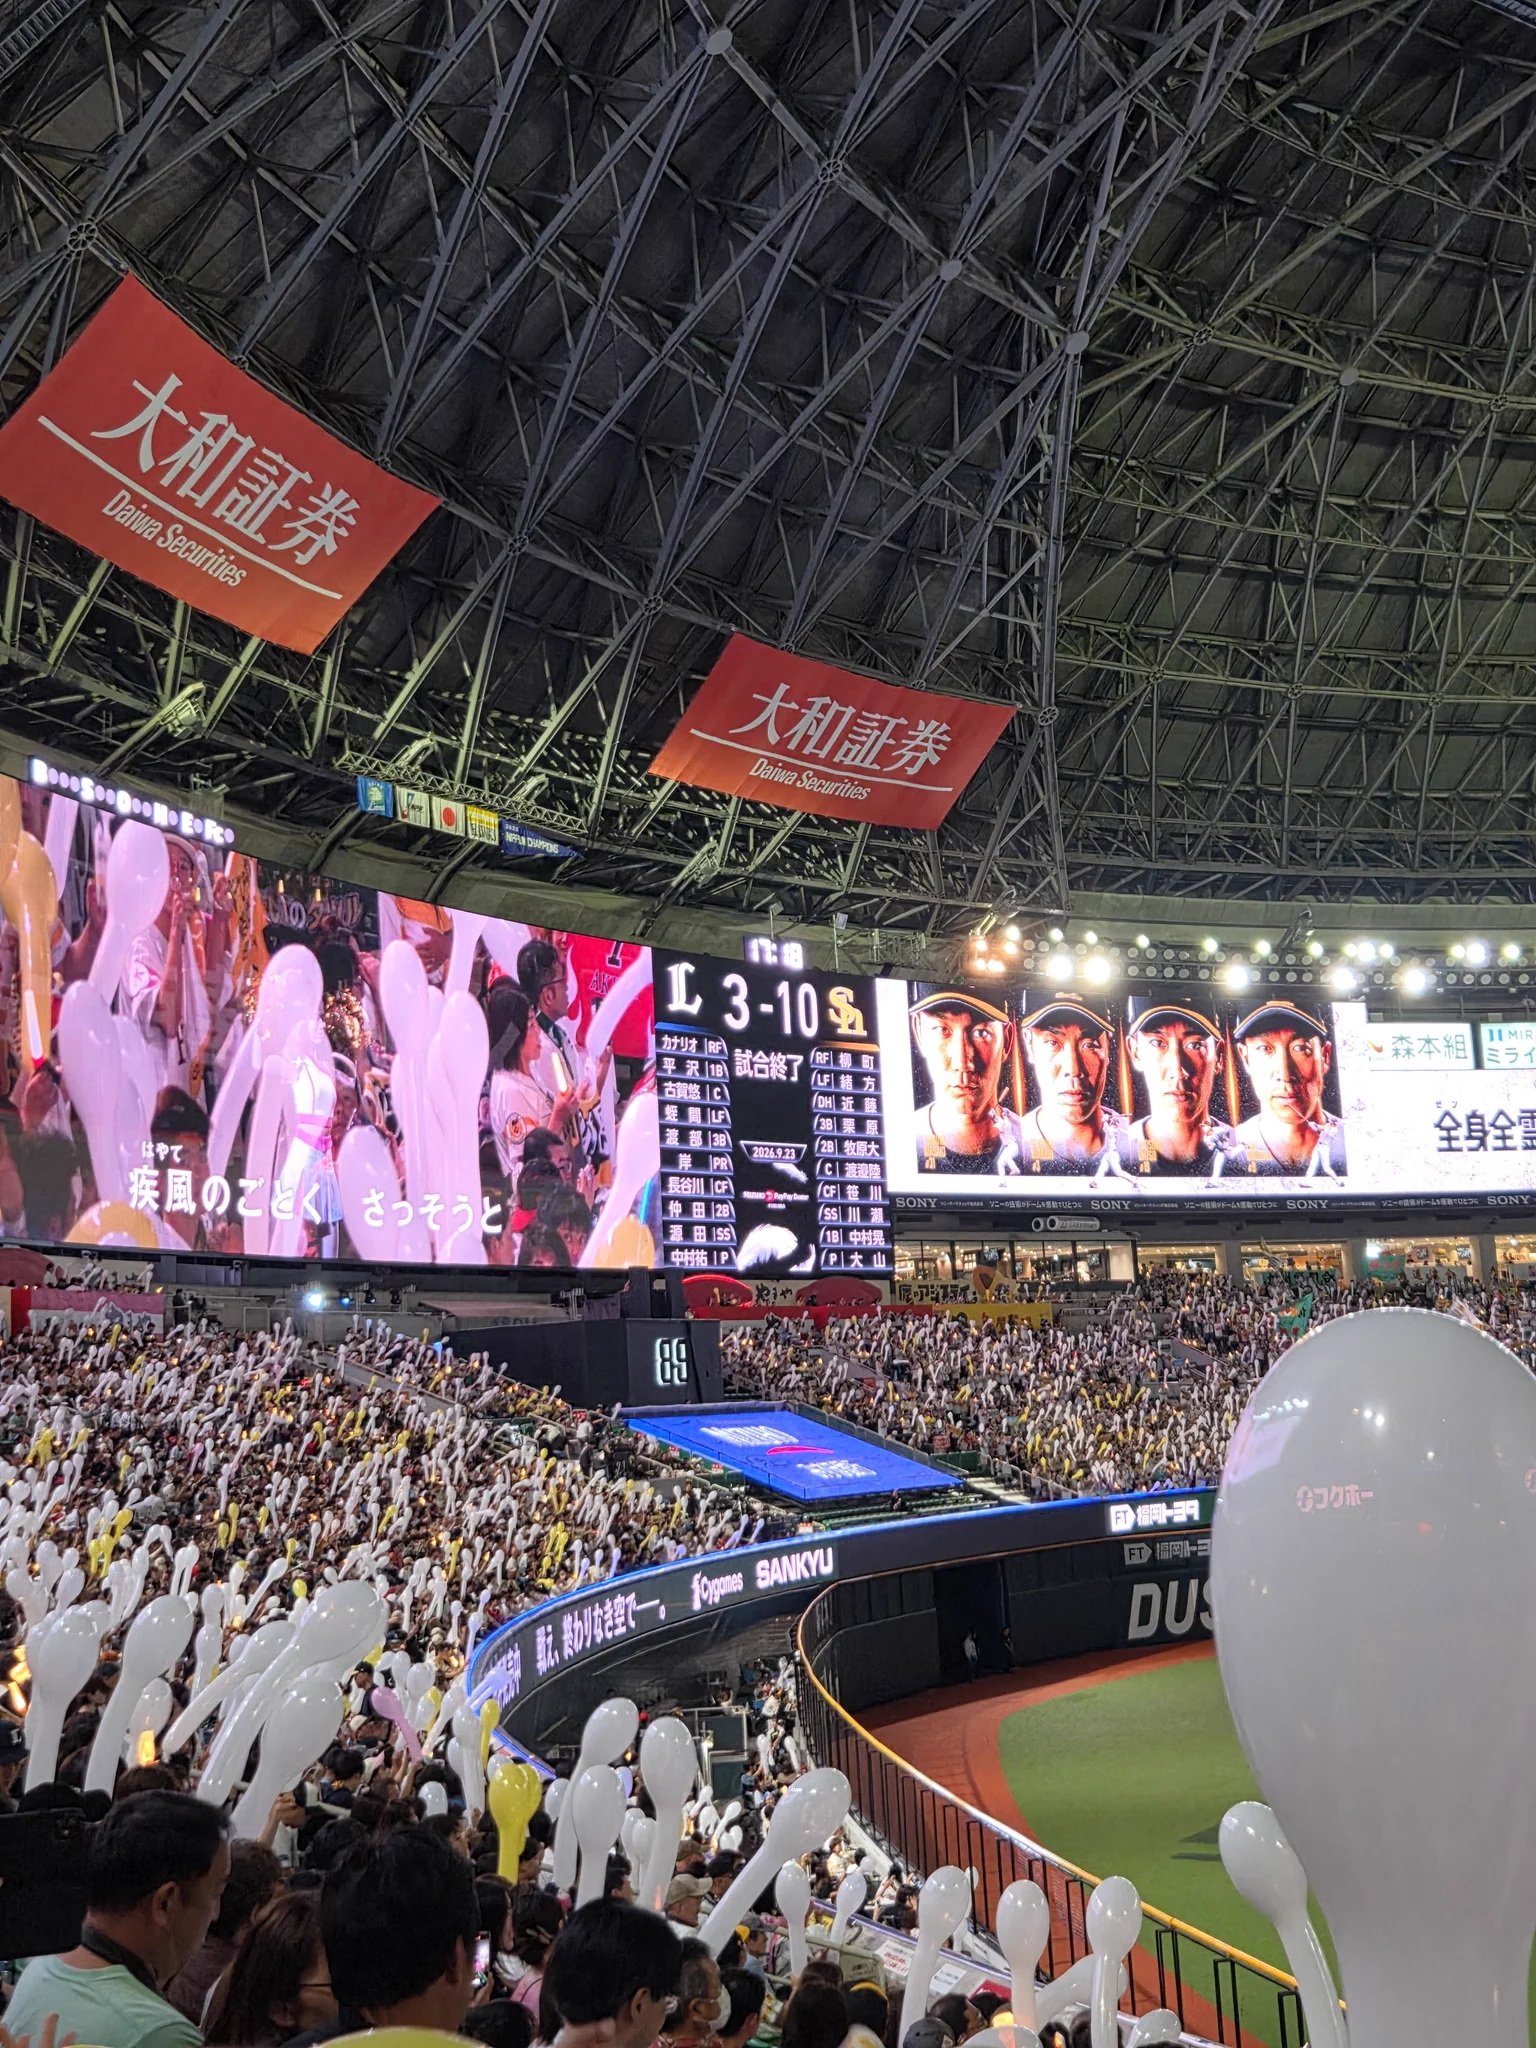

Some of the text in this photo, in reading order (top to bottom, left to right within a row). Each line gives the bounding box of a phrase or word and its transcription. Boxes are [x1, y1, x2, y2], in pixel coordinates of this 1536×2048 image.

[90, 373, 360, 565] 大和証券
[102, 489, 248, 588] Daiwa Securities
[729, 682, 952, 776] 大和証券
[749, 758, 871, 801] Daiwa Securities
[32, 758, 48, 784] B
[80, 776, 95, 800] S
[153, 802, 168, 826] H
[180, 811, 195, 834] E
[527, 837, 559, 854] CHAMPIONS
[751, 938, 803, 968] 17:18
[1508, 1029, 1536, 1040] MIR
[661, 1034, 722, 1054] カナリオ RF
[1391, 1034, 1469, 1060] 森本組
[815, 1051, 829, 1064] RF
[1487, 1046, 1536, 1064] ミライ
[710, 1064, 724, 1077] 1B
[734, 1048, 804, 1081] 試合終了
[817, 1073, 831, 1086] LF
[663, 1080, 722, 1100] 古賀悠 C
[817, 1095, 832, 1109] DH
[711, 1110, 725, 1123] LF
[819, 1117, 833, 1131] 3B
[1433, 1108, 1536, 1152] 全身全霊
[712, 1133, 727, 1147] 3B
[820, 1140, 880, 1157] 2B 牧原大
[141, 1140, 184, 1163] はやて
[752, 1146, 796, 1160] 2026.9.23
[678, 1153, 728, 1171] 岸 PR
[824, 1162, 833, 1176] C
[668, 1176, 729, 1195] 長谷川 CF
[822, 1184, 837, 1198] CF
[128, 1164, 503, 1234] 疾風のごとく さっそうと
[774, 1192, 793, 1202] PayPay
[895, 1197, 938, 1208] SONY
[1091, 1200, 1131, 1210] SONY
[1286, 1200, 1329, 1210] SONY
[1487, 1195, 1531, 1206] SONY
[715, 1203, 730, 1217] 2B
[824, 1207, 838, 1220] SS
[716, 1227, 731, 1241] SS
[825, 1229, 885, 1246] 1B 中村晃
[671, 1248, 729, 1266] 中村祐 P
[829, 1253, 838, 1266] P
[654, 1337, 689, 1386] 89
[1136, 1499, 1200, 1526] 福岡トヨタ
[1129, 1547, 1145, 1561] FT
[755, 1547, 834, 1590] SANKYU
[701, 1571, 744, 1606] Cygames
